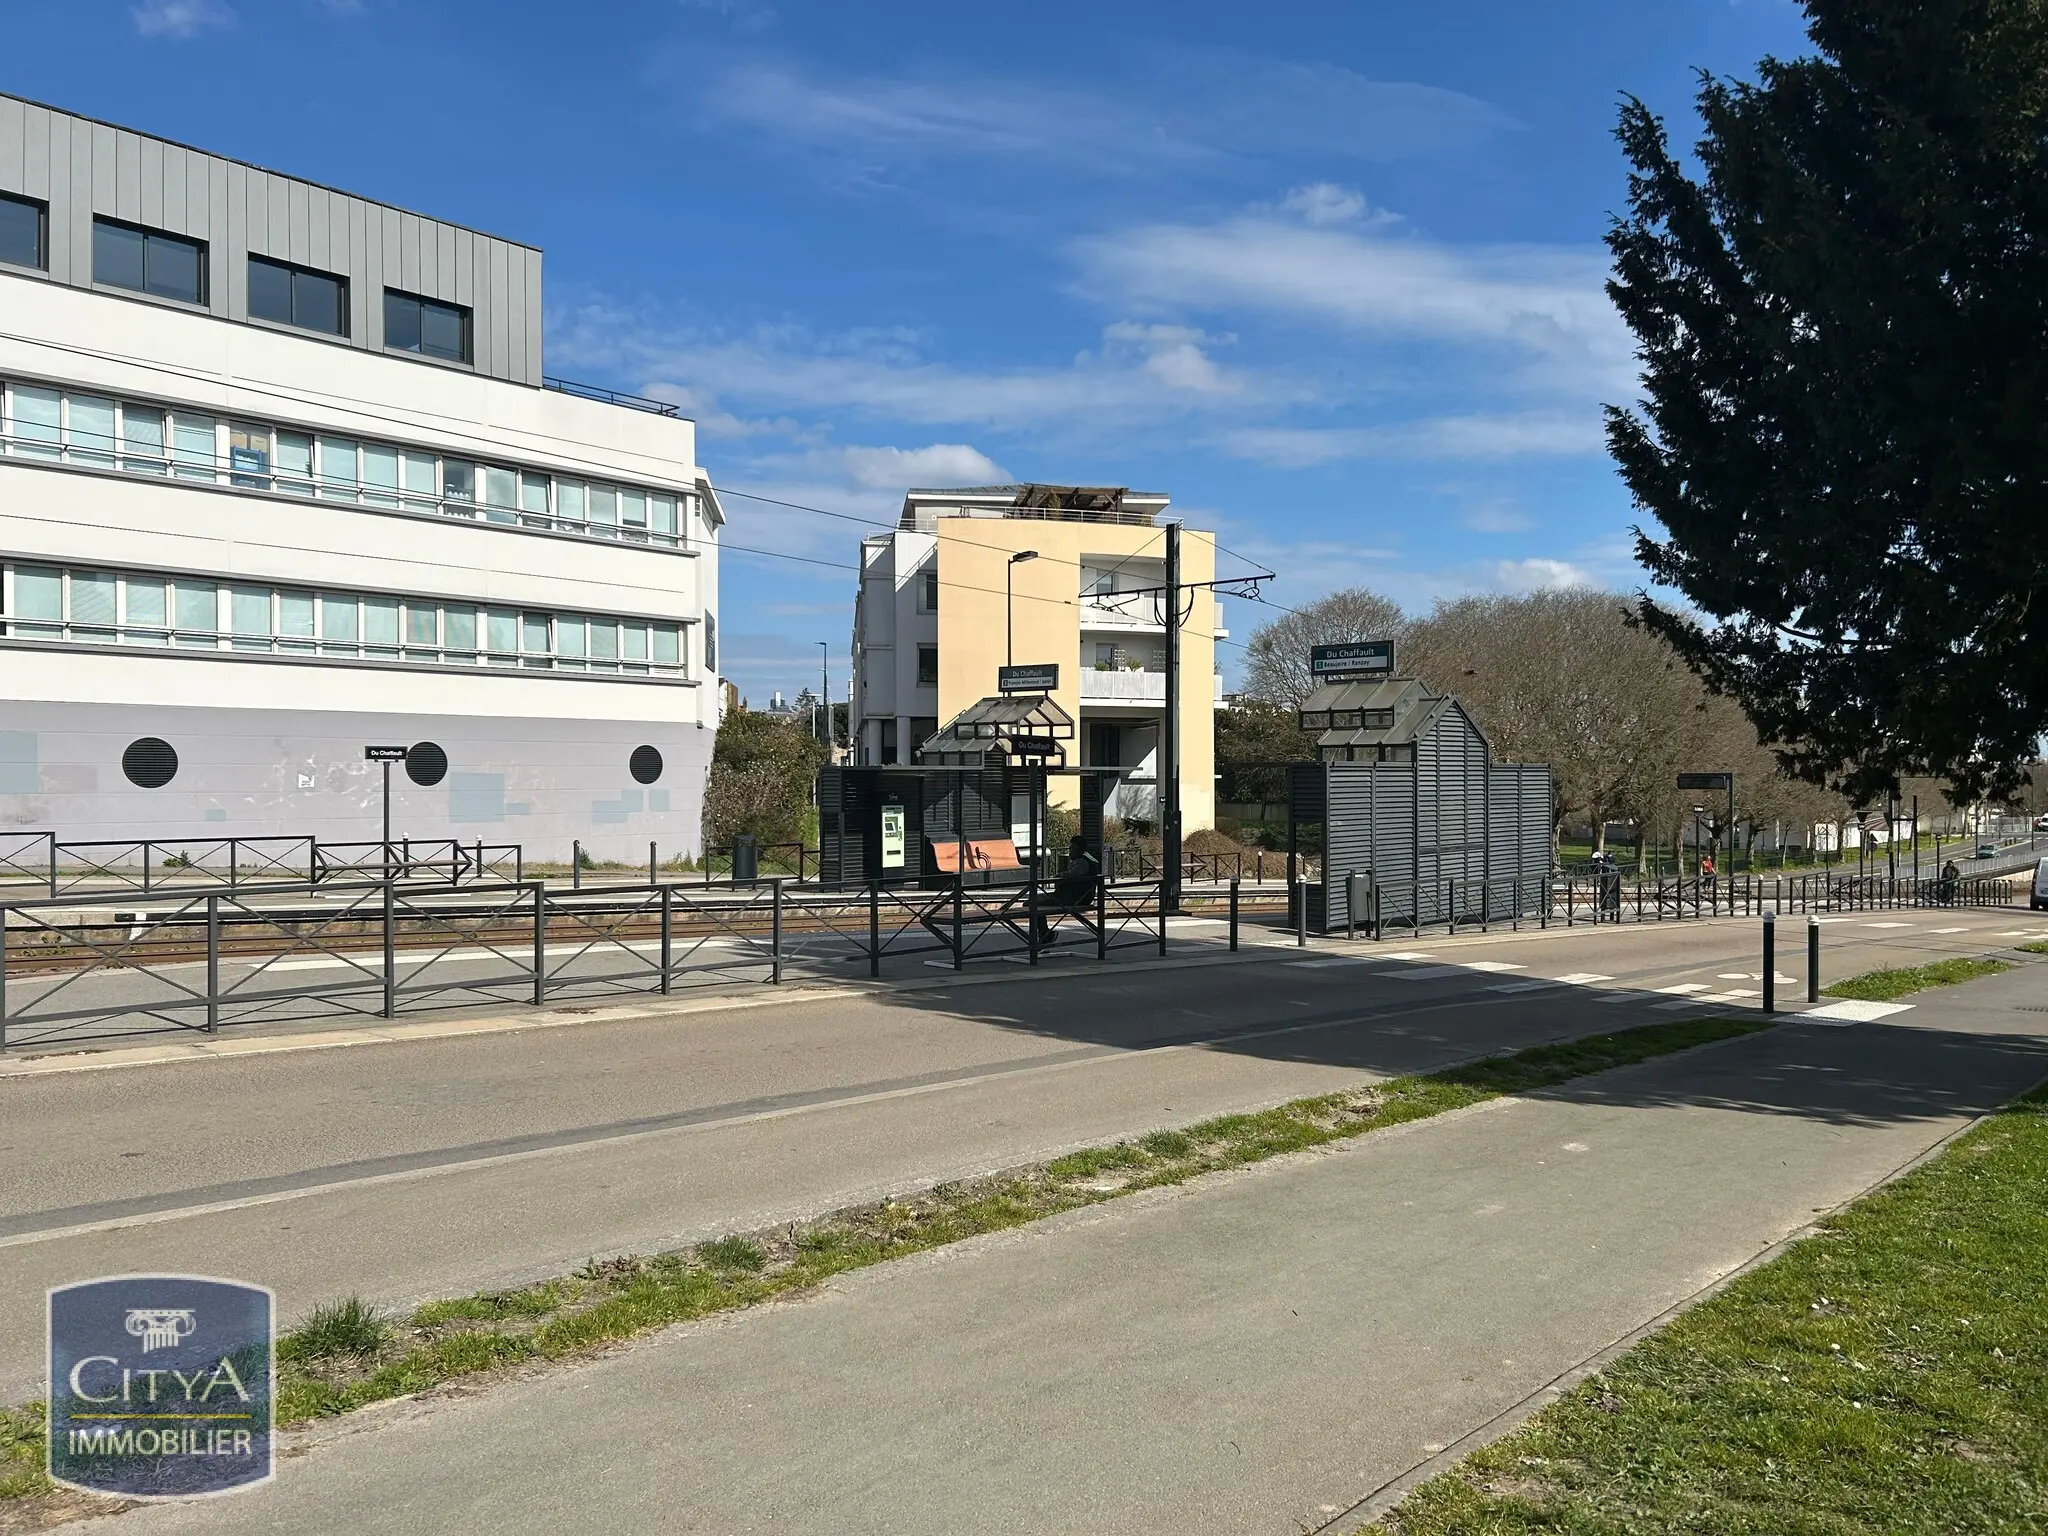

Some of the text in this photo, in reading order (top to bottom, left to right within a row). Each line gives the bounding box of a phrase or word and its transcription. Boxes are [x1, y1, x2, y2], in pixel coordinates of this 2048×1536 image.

[1326, 647, 1375, 658] Du Chaffault
[1324, 661, 1347, 669] Beaujoire
[1020, 669, 1043, 677] Chaffault
[1018, 741, 1027, 749] Du
